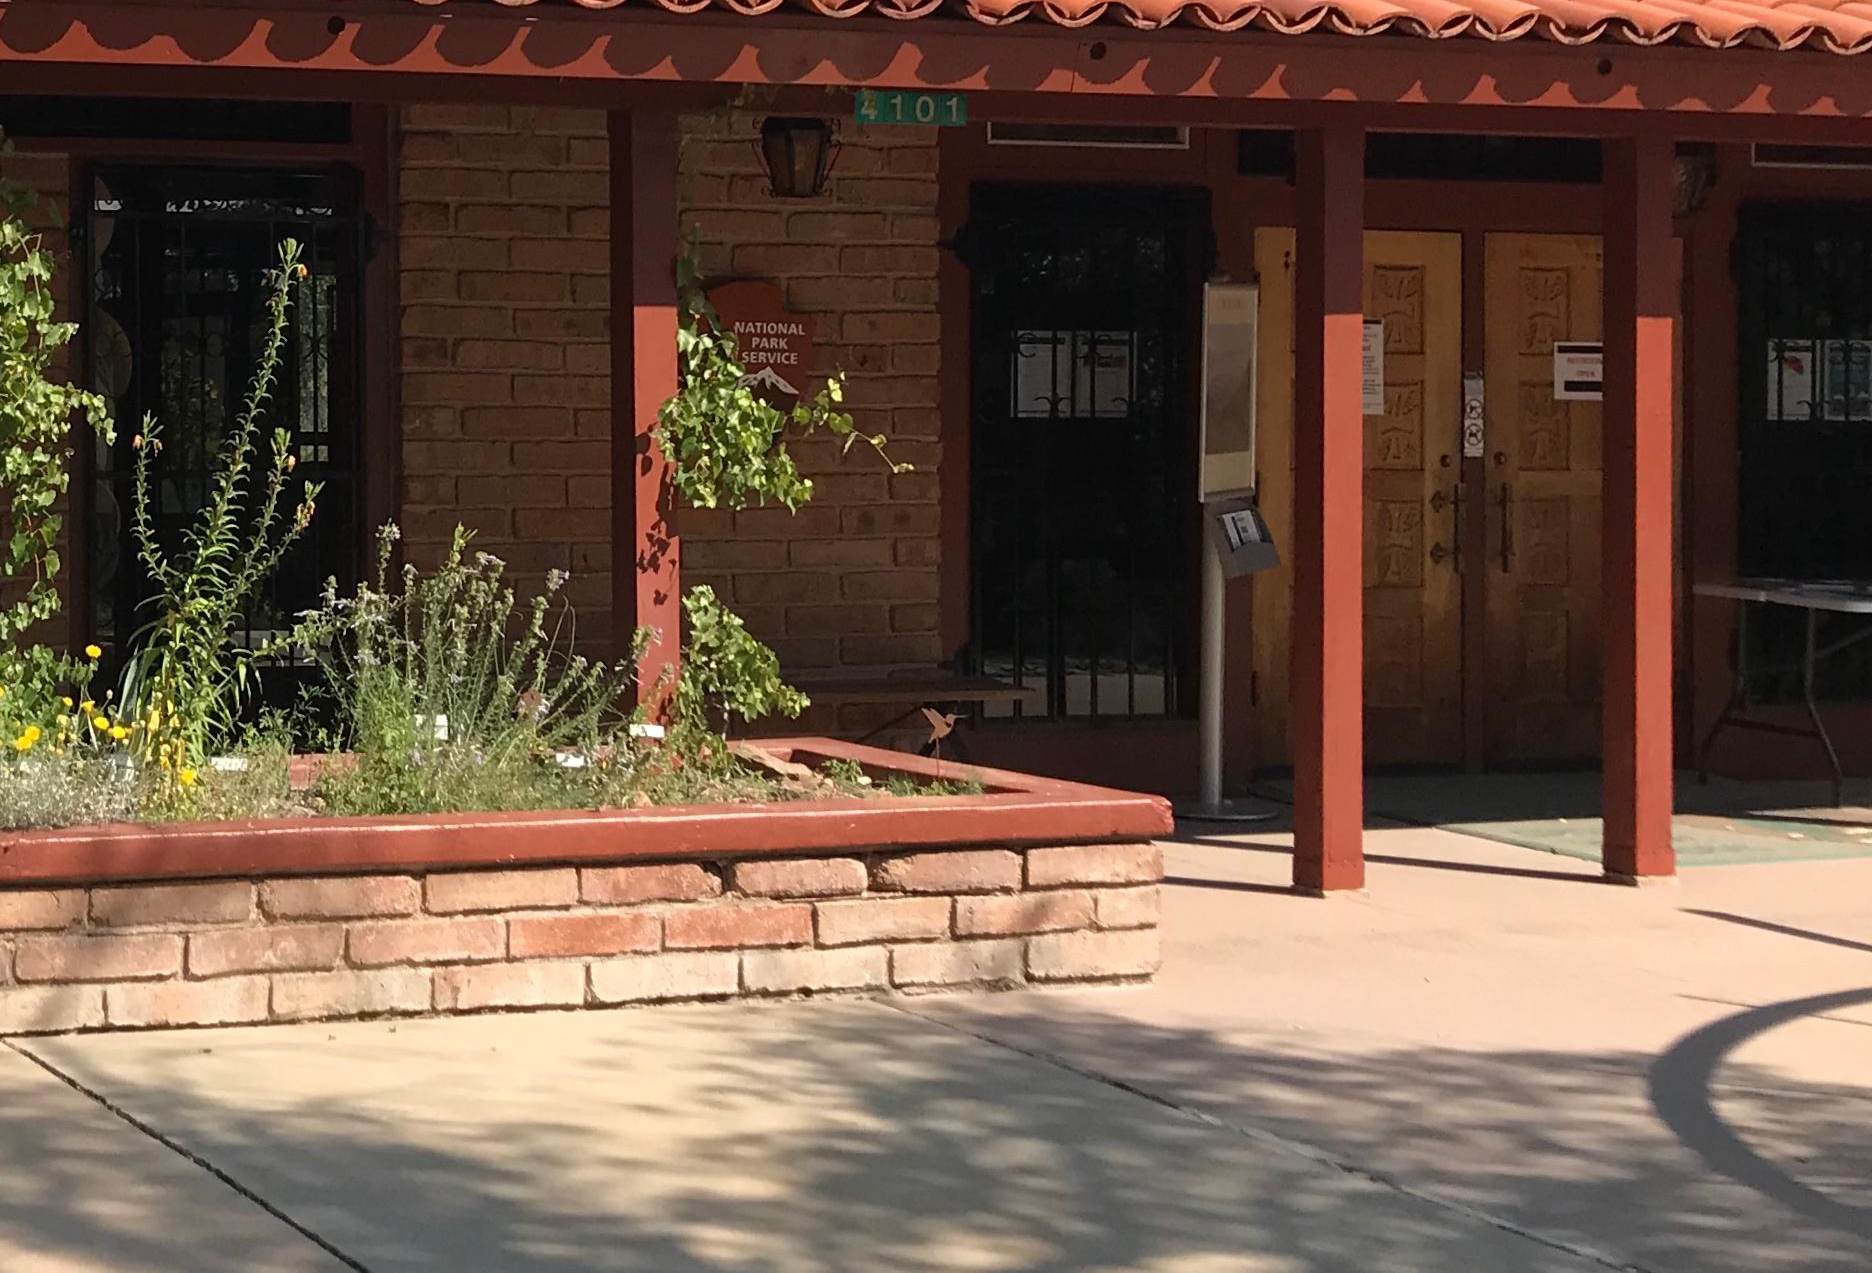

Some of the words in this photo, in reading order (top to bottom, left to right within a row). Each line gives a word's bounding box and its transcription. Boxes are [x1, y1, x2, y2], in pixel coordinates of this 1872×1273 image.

[861, 93, 958, 123] 4101
[734, 321, 806, 336] NATIONAL
[752, 337, 788, 349] PARK
[742, 351, 798, 365] SERVICE
